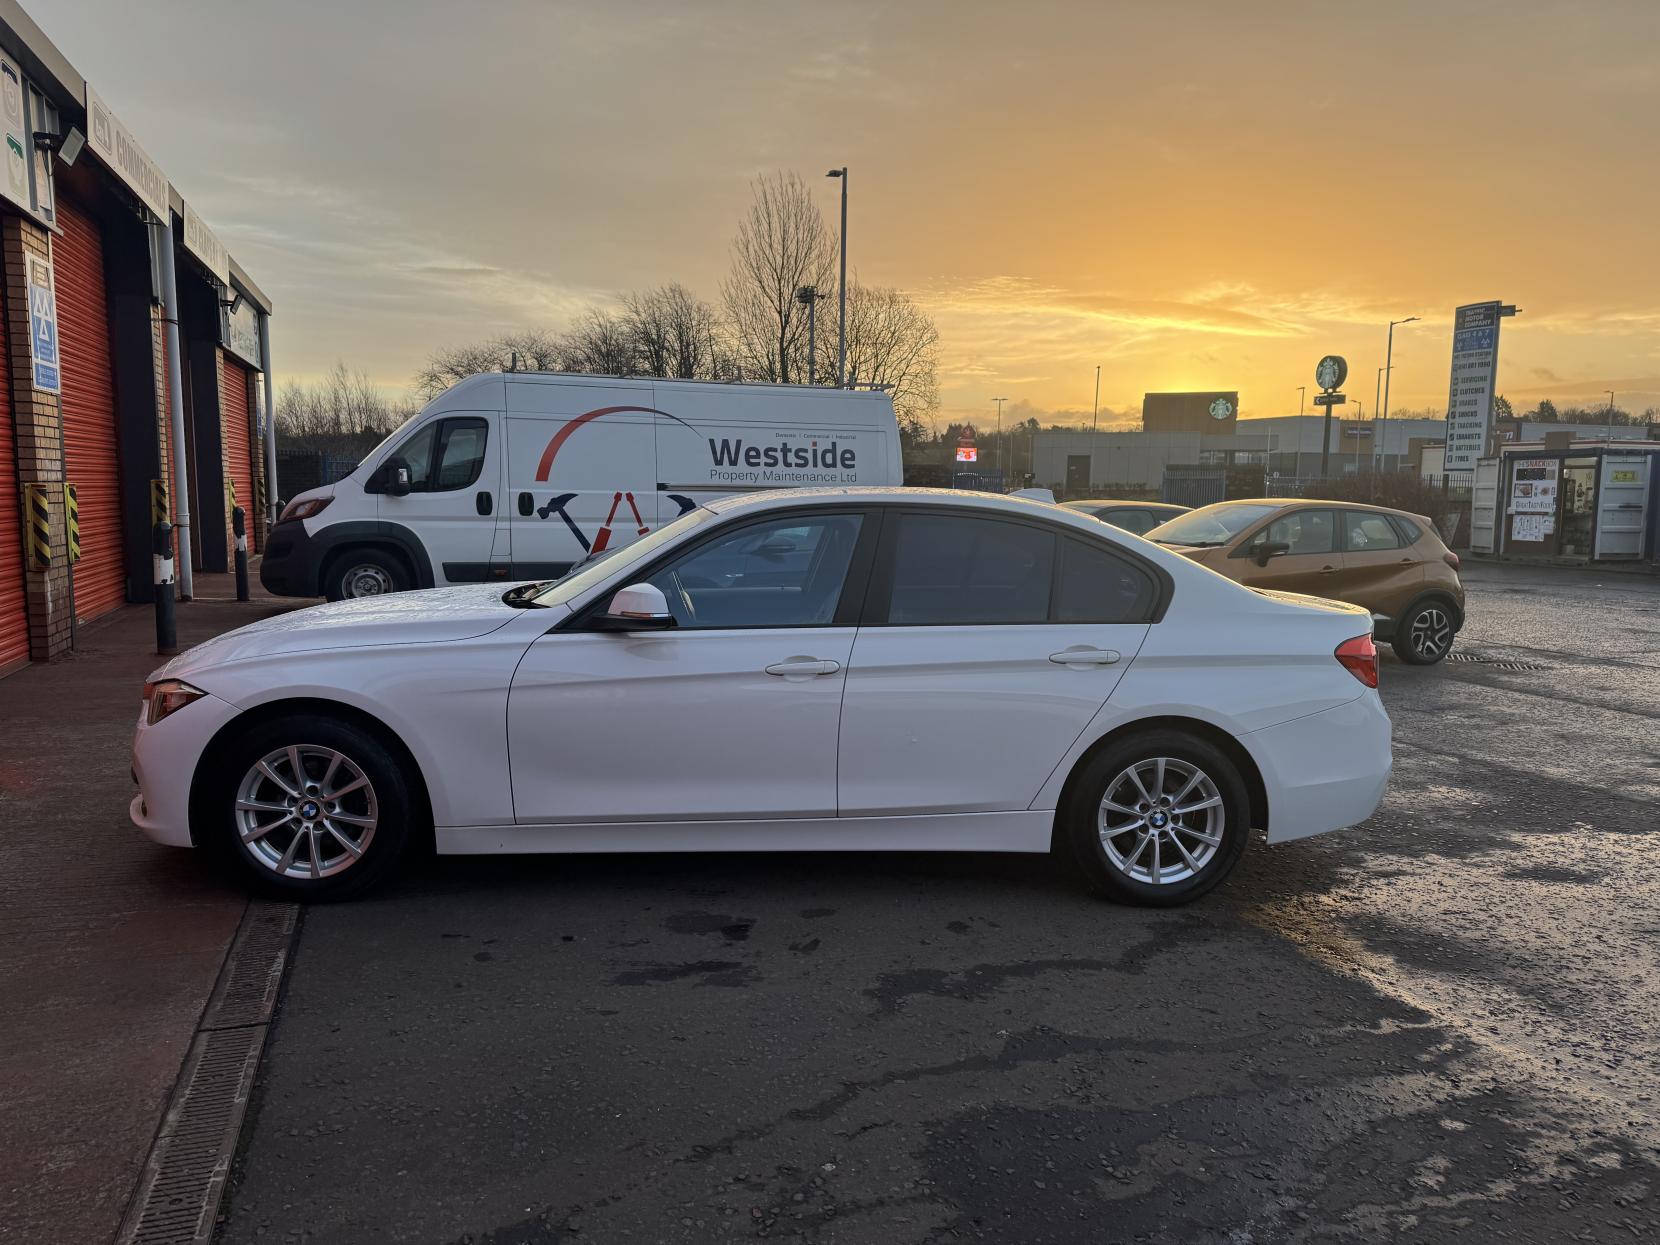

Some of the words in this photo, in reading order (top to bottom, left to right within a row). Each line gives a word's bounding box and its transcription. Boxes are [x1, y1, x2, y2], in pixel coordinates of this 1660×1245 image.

[708, 438, 856, 469] Westside
[710, 469, 759, 483] Property
[763, 470, 837, 482] Maintenance
[840, 472, 857, 482] Ltd
